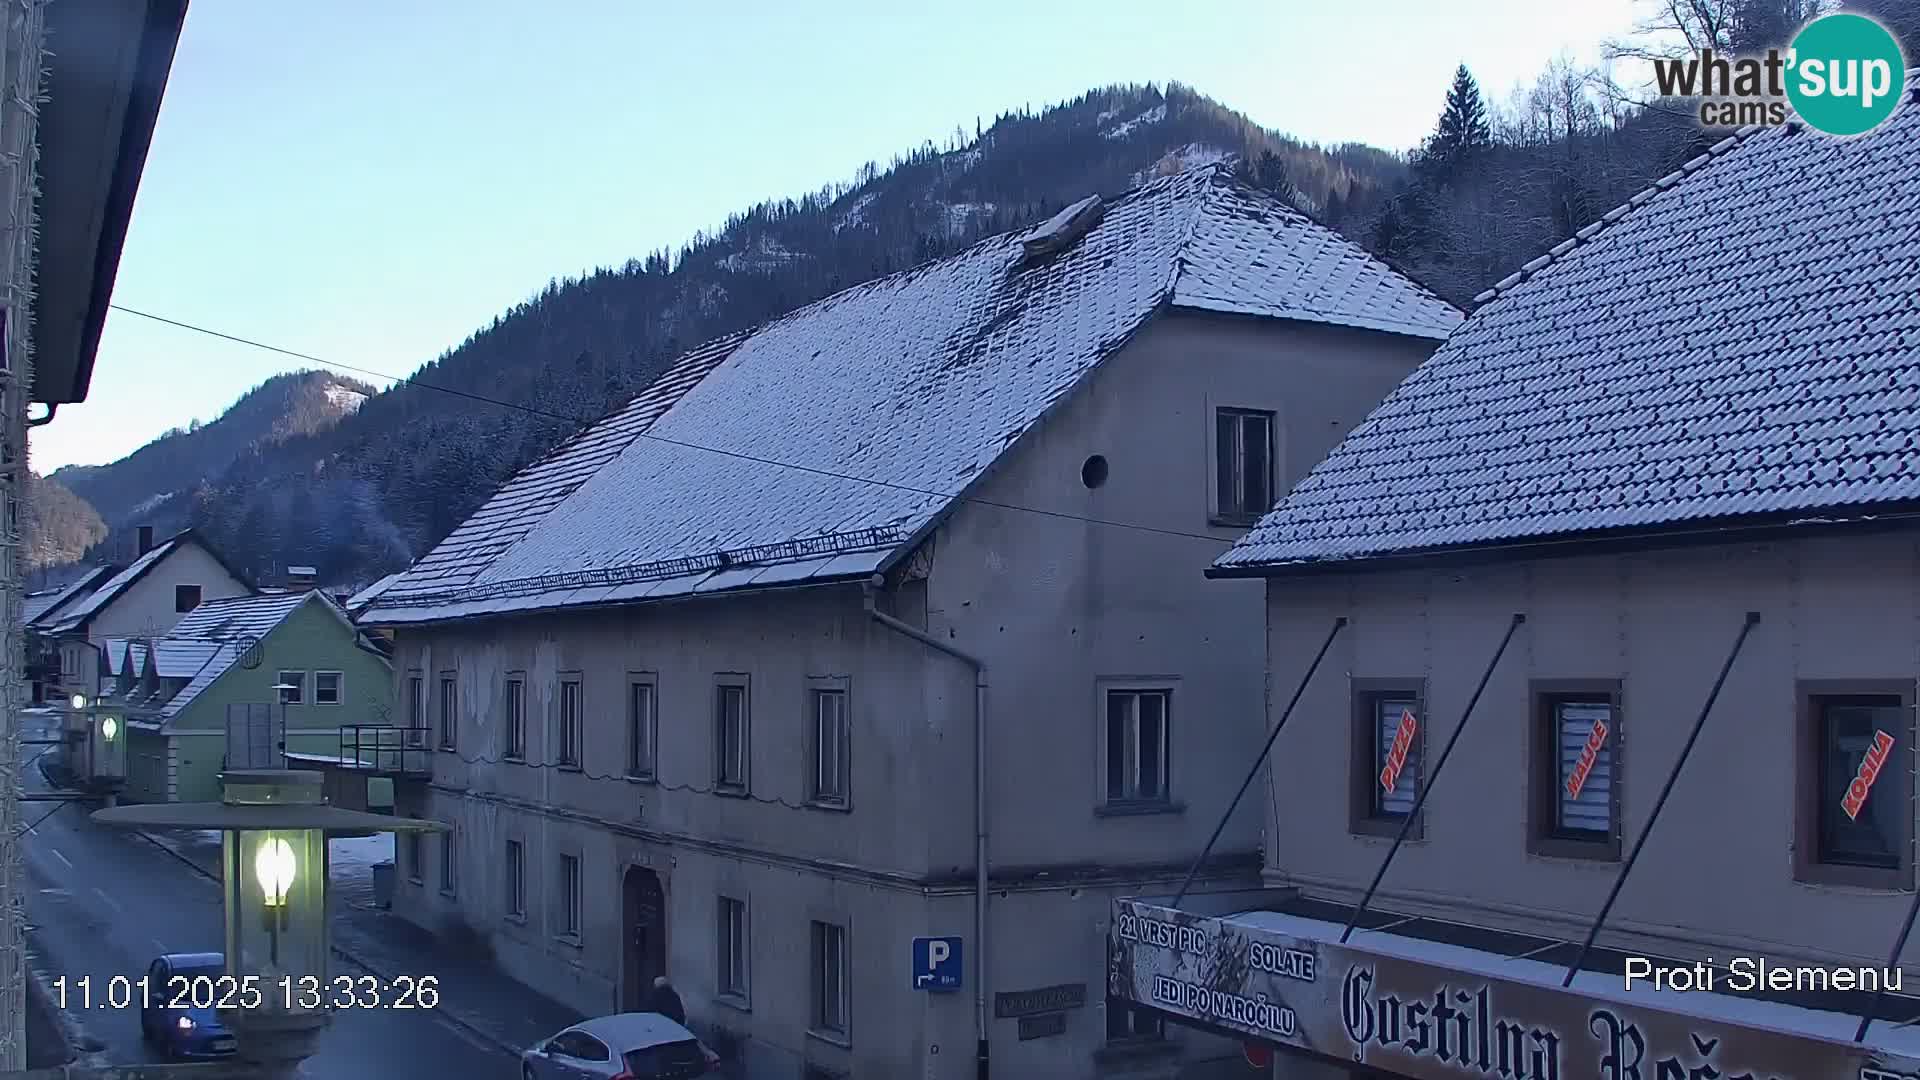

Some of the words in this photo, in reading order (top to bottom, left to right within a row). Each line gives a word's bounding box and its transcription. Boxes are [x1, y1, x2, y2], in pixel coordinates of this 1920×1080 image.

[1380, 708, 1416, 794] PIZZE
[1566, 719, 1607, 801] MALICE
[1841, 729, 1895, 820] KOSILA
[929, 940, 950, 970] P
[1119, 914, 1138, 940] 21
[1139, 915, 1178, 949] VRST
[1180, 926, 1206, 954] PIC
[1250, 942, 1315, 981] SOLATE
[1153, 976, 1185, 1006] JEDI
[1186, 984, 1210, 1013] PO
[1211, 992, 1296, 1036] NAROČILU
[1340, 961, 1563, 1080] Gostilna
